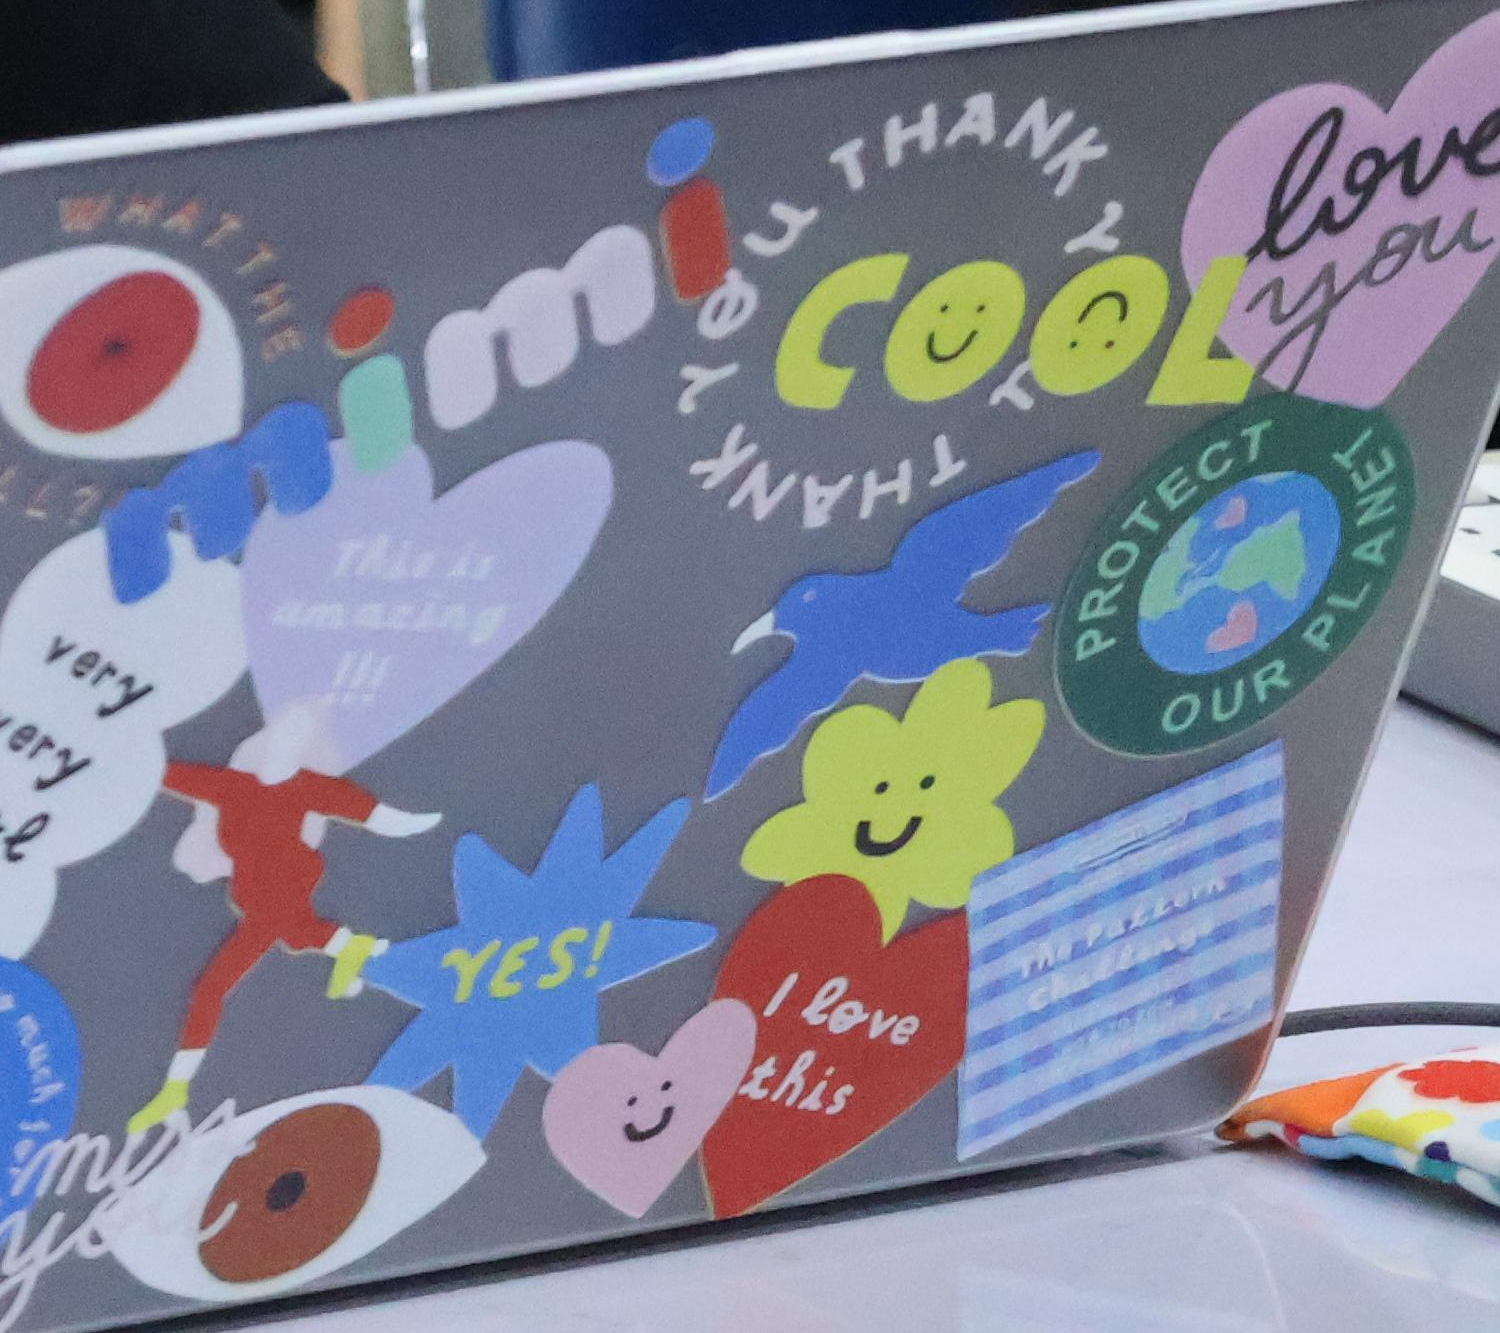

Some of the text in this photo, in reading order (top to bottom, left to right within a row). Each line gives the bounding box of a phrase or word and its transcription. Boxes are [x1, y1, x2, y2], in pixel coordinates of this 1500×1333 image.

[830, 92, 1108, 197] THANK
[59, 190, 303, 365] WHAT THE
[679, 201, 818, 414] YOU
[1245, 207, 1495, 393] you
[775, 253, 1257, 411] COOL
[689, 423, 967, 528] THANK
[447, 541, 495, 580] is
[1075, 419, 1274, 662] PROTECT
[1161, 427, 1397, 734] OUR PLANET
[271, 591, 506, 645] amazing
[45, 634, 154, 718] very
[441, 920, 613, 1004] YES!
[762, 972, 921, 1046] I love
[738, 1049, 856, 1116] this
